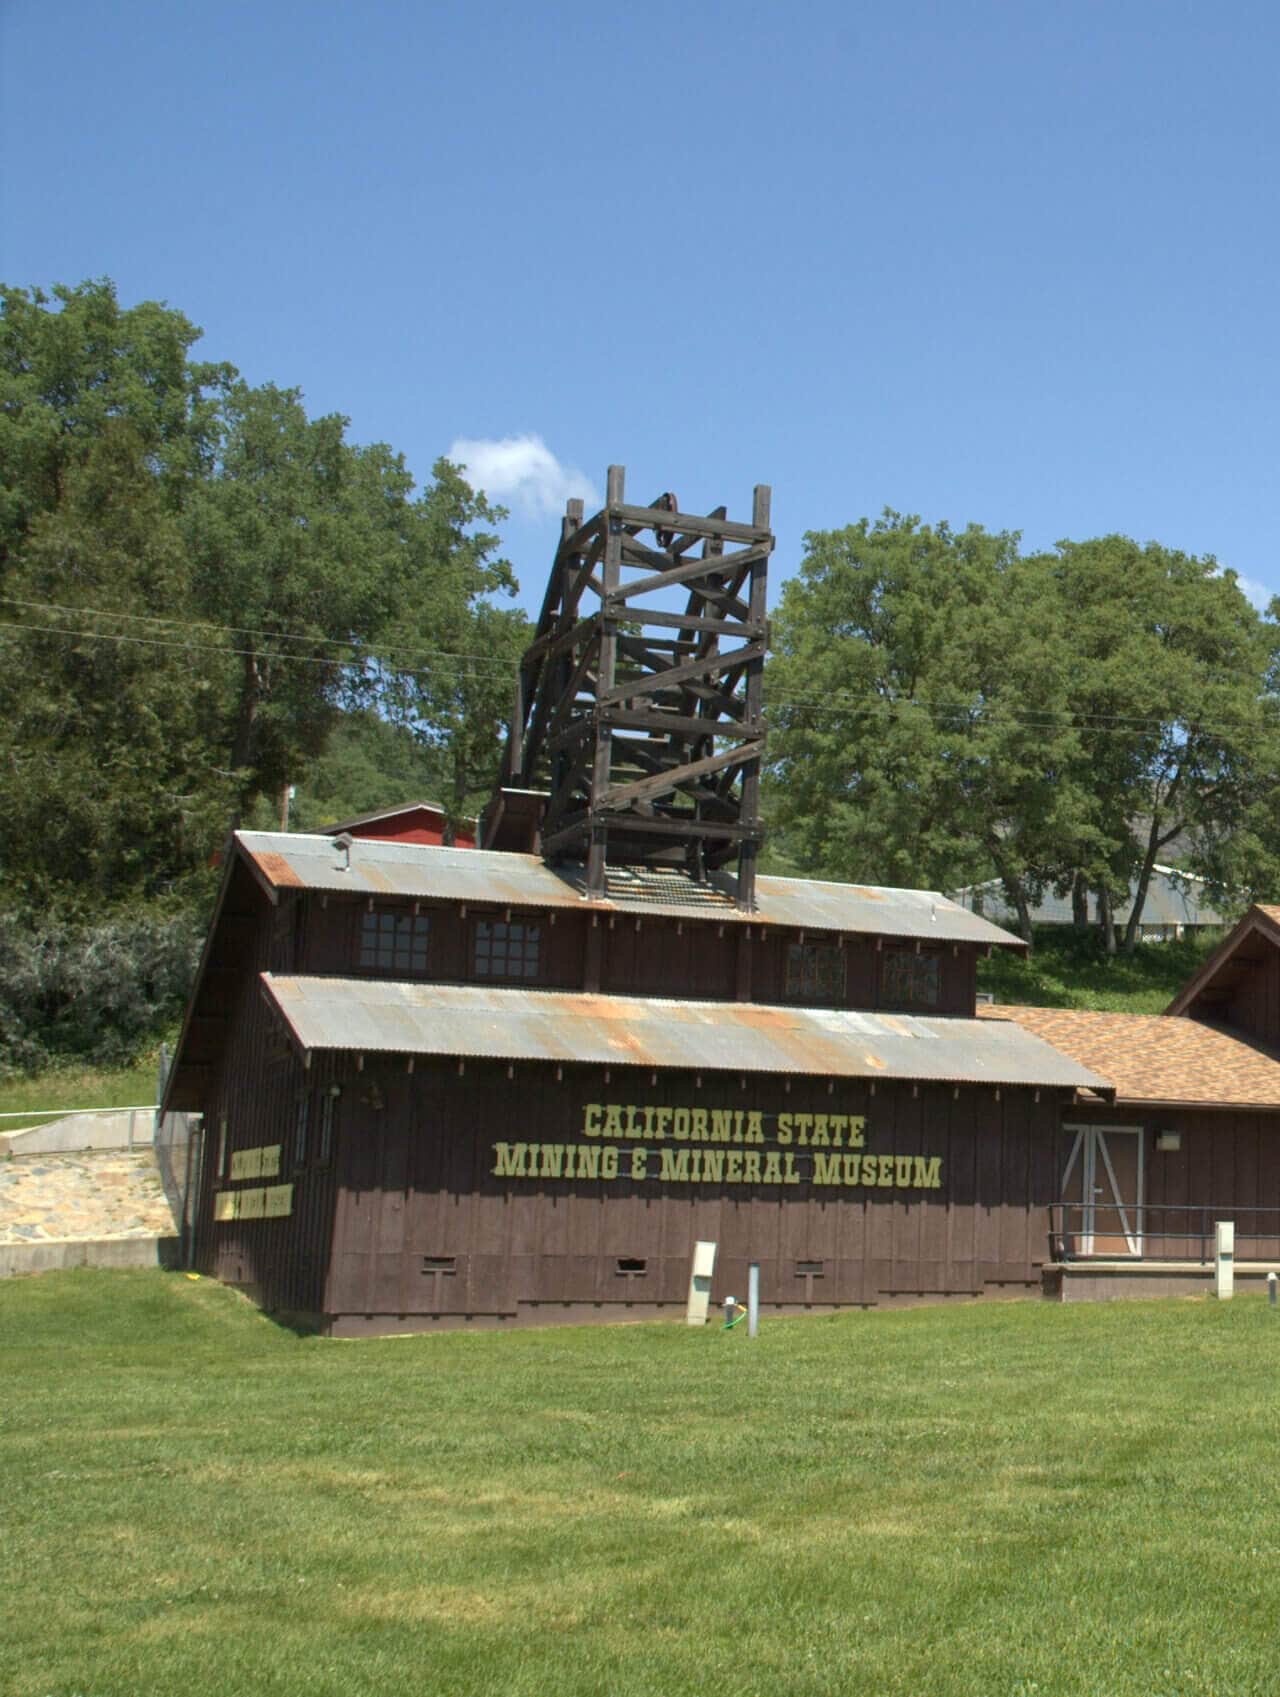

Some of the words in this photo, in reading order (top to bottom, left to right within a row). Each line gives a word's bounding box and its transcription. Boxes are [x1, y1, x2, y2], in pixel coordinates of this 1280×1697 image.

[584, 1104, 764, 1143] CALIFORNIA
[777, 1113, 864, 1147] STATE
[494, 1142, 618, 1179] MINING
[631, 1147, 648, 1180] &
[660, 1148, 800, 1184] MINERAL
[812, 1152, 942, 1188] MUSEUM
